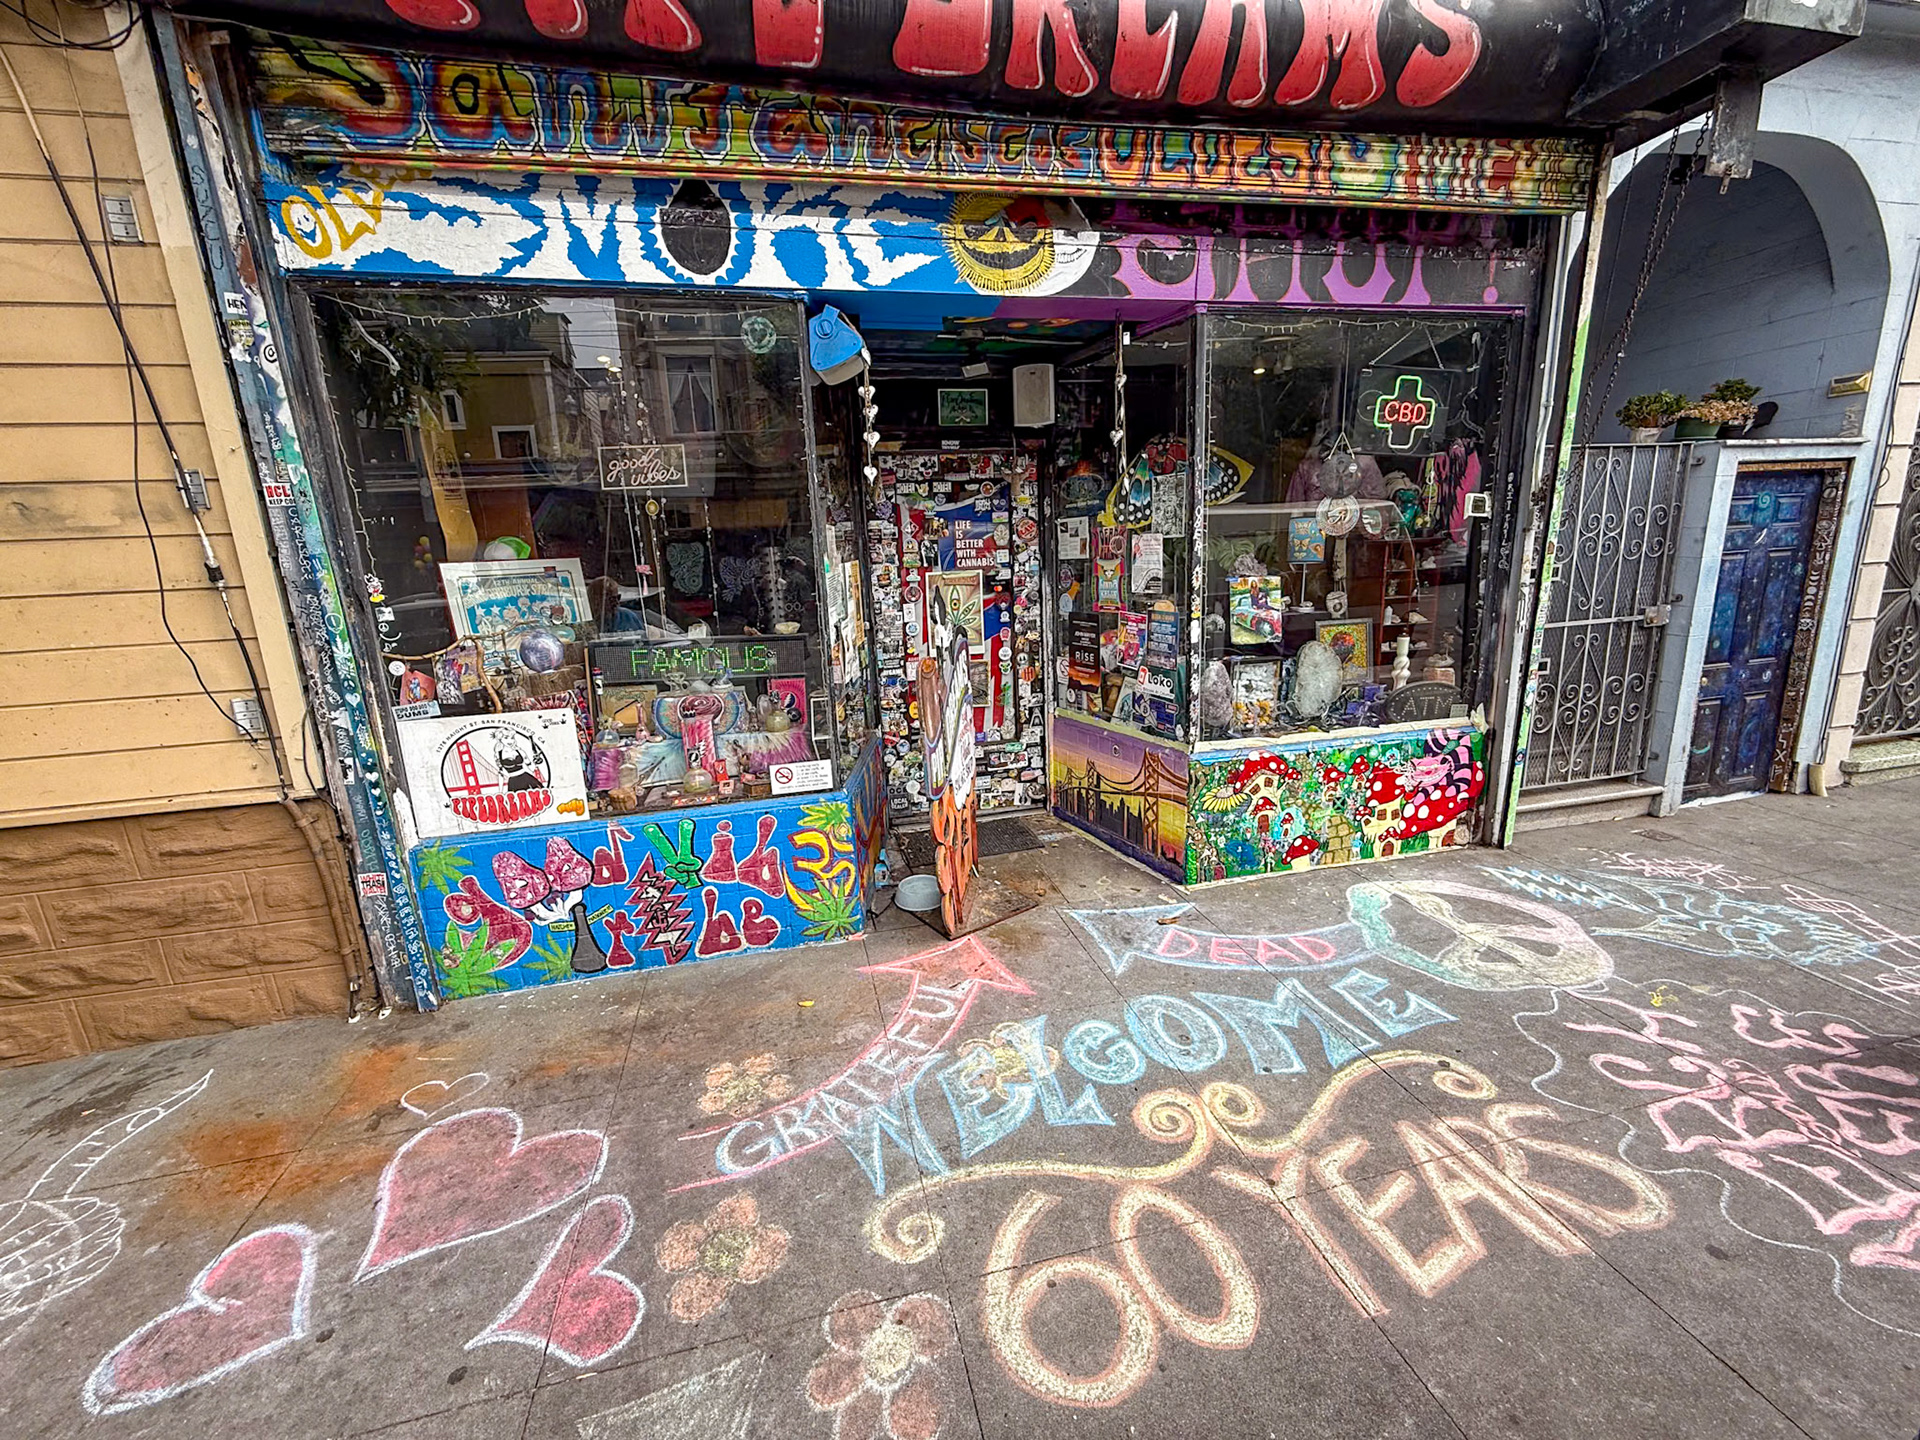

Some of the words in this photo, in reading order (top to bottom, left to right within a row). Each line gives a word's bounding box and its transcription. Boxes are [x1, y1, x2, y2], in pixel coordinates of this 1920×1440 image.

[1383, 400, 1428, 424] CBD
[607, 448, 656, 483] good
[630, 458, 682, 486] vibes
[955, 520, 971, 530] LIFE
[955, 530, 963, 540] IS
[955, 538, 984, 549] BETTER
[956, 548, 976, 558] WITH
[956, 557, 995, 568] CANNABIS
[630, 644, 771, 677] FAMOUS
[396, 709, 429, 719] DUMB
[1400, 695, 1452, 717] ATM
[446, 725, 469, 741] HAIGHT
[715, 976, 960, 1178] GRATEFUL
[1156, 927, 1340, 967] DEAD
[828, 965, 1460, 1198] WELCOME
[981, 1176, 1264, 1410] 60
[1211, 1102, 1679, 1320] YEARS
